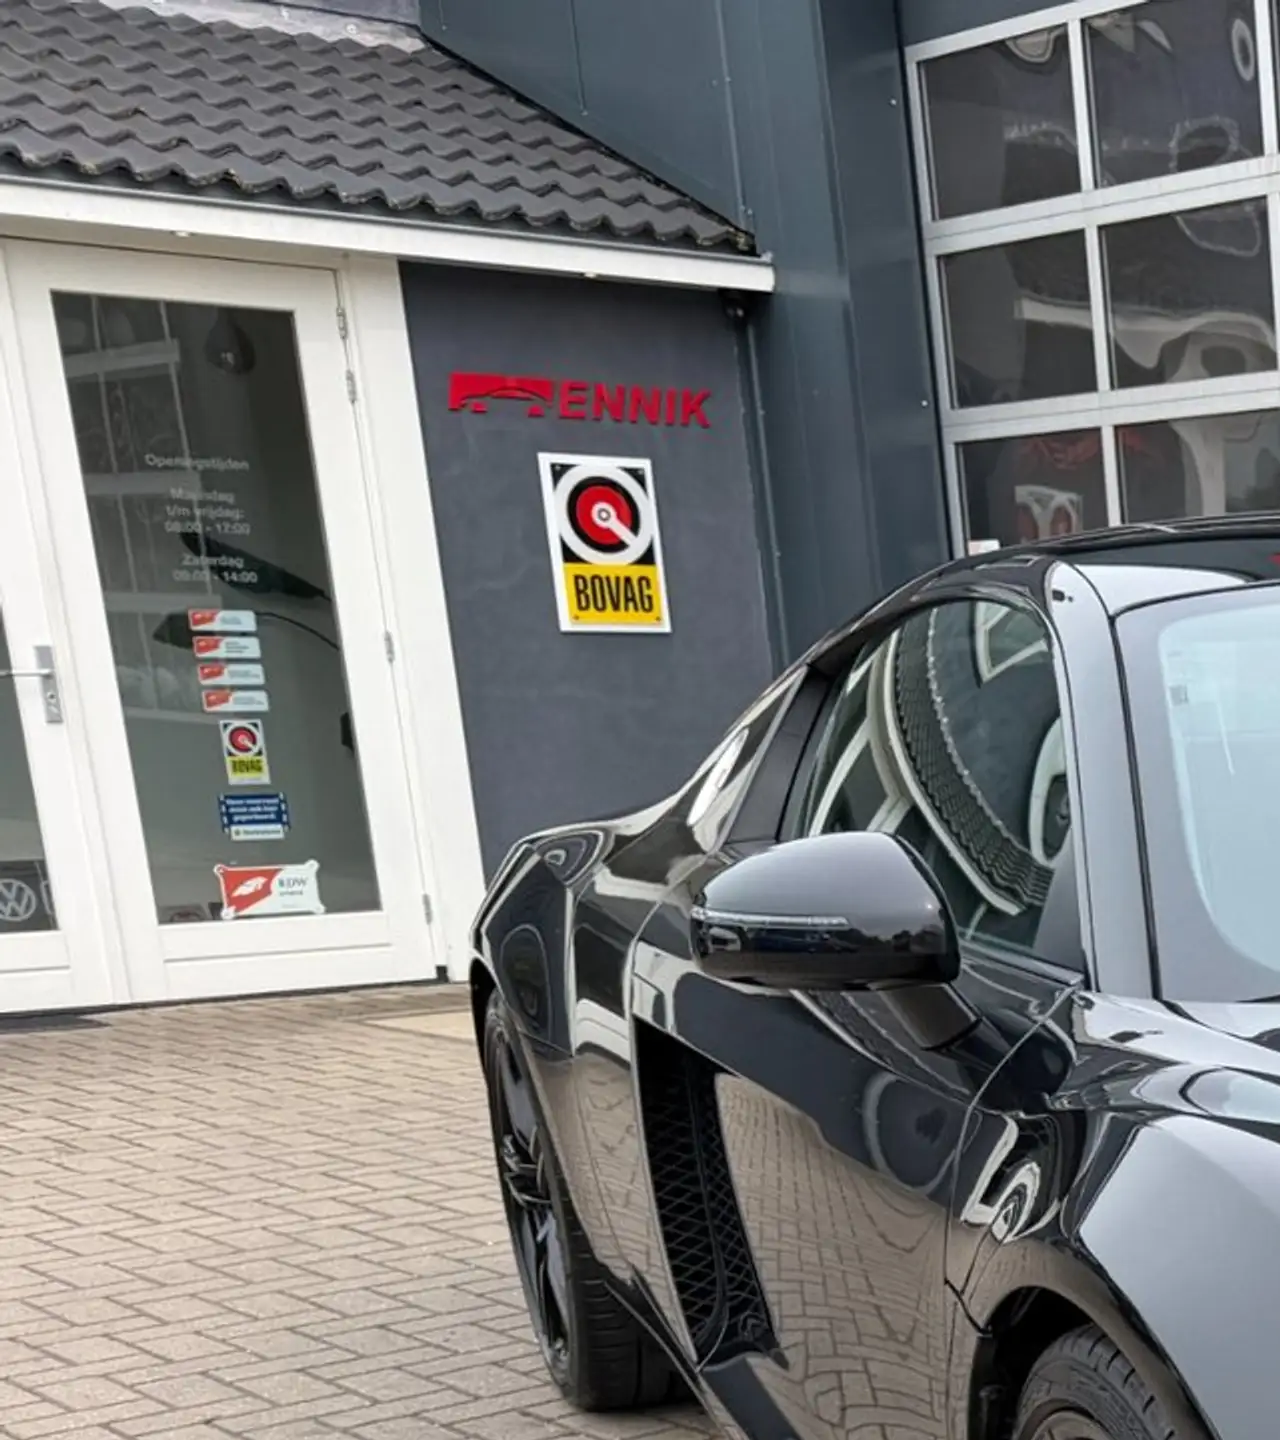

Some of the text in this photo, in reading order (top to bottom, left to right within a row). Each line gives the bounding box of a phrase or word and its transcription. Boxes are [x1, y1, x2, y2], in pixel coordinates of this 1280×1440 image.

[144, 453, 249, 471] Openingstijden
[182, 552, 244, 569] Zaterdag
[222, 571, 258, 584] 14:00
[573, 573, 654, 613] BOVAG
